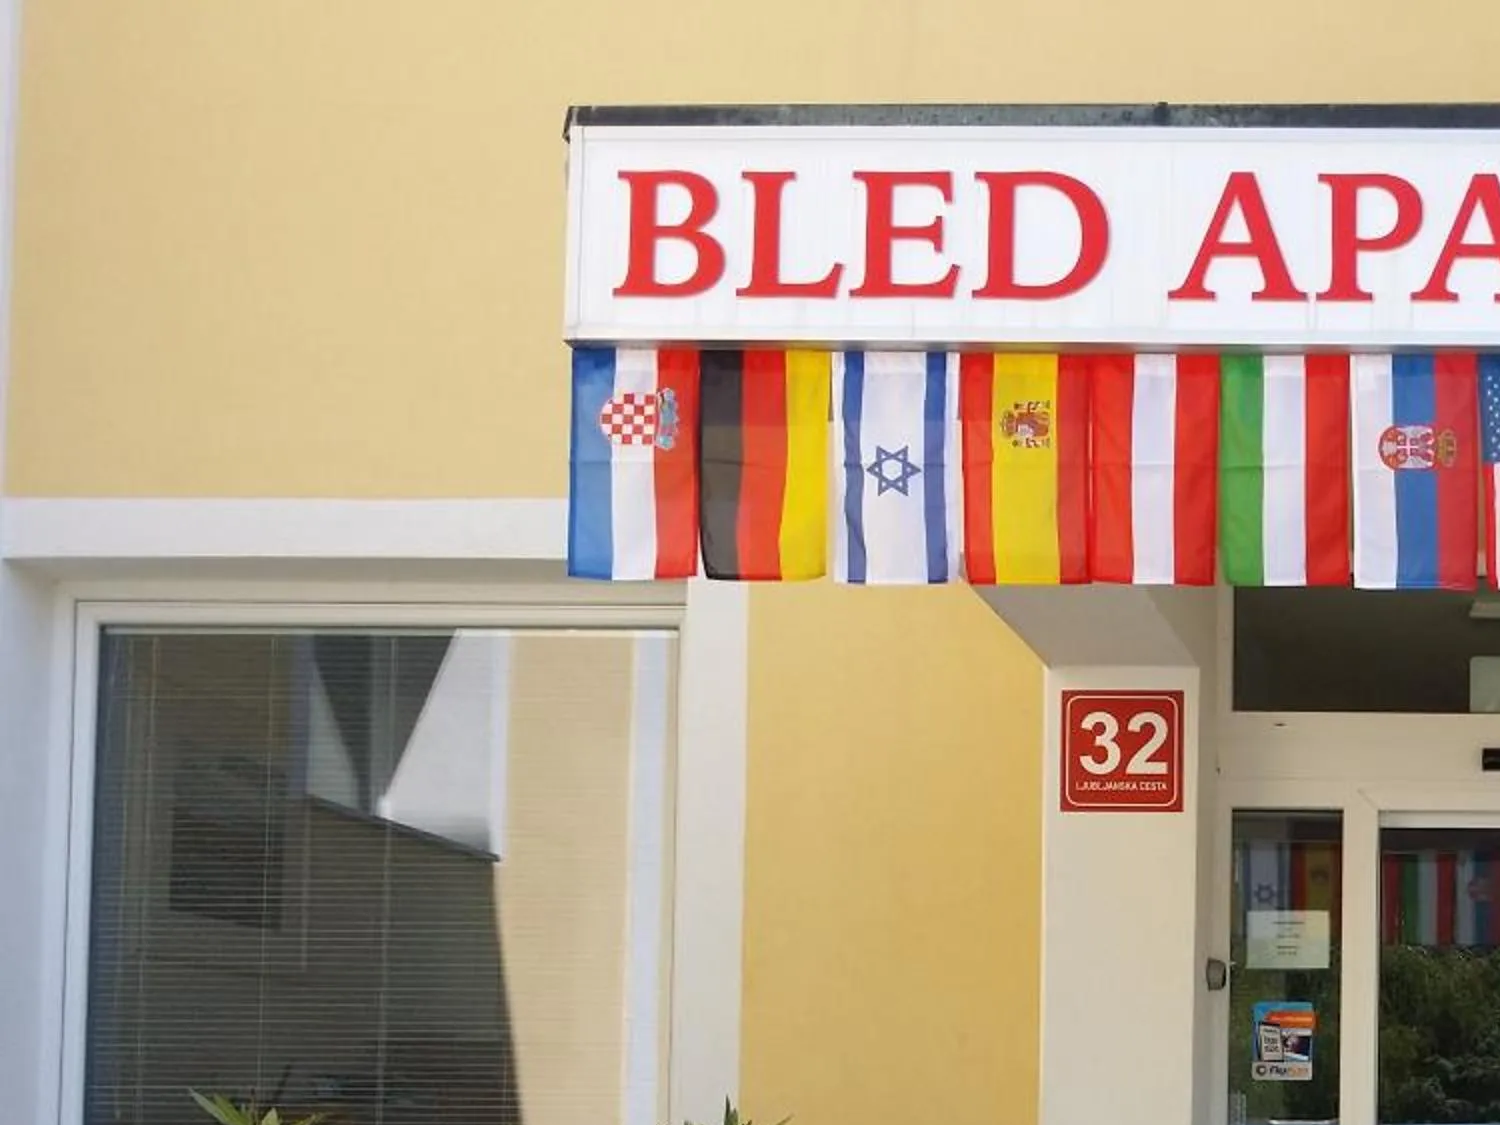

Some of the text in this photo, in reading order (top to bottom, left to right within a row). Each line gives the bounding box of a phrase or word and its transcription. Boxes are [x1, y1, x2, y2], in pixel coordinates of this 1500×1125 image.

[612, 170, 1110, 301] BLED
[1079, 711, 1168, 775] 32
[1139, 781, 1168, 791] CESTA
